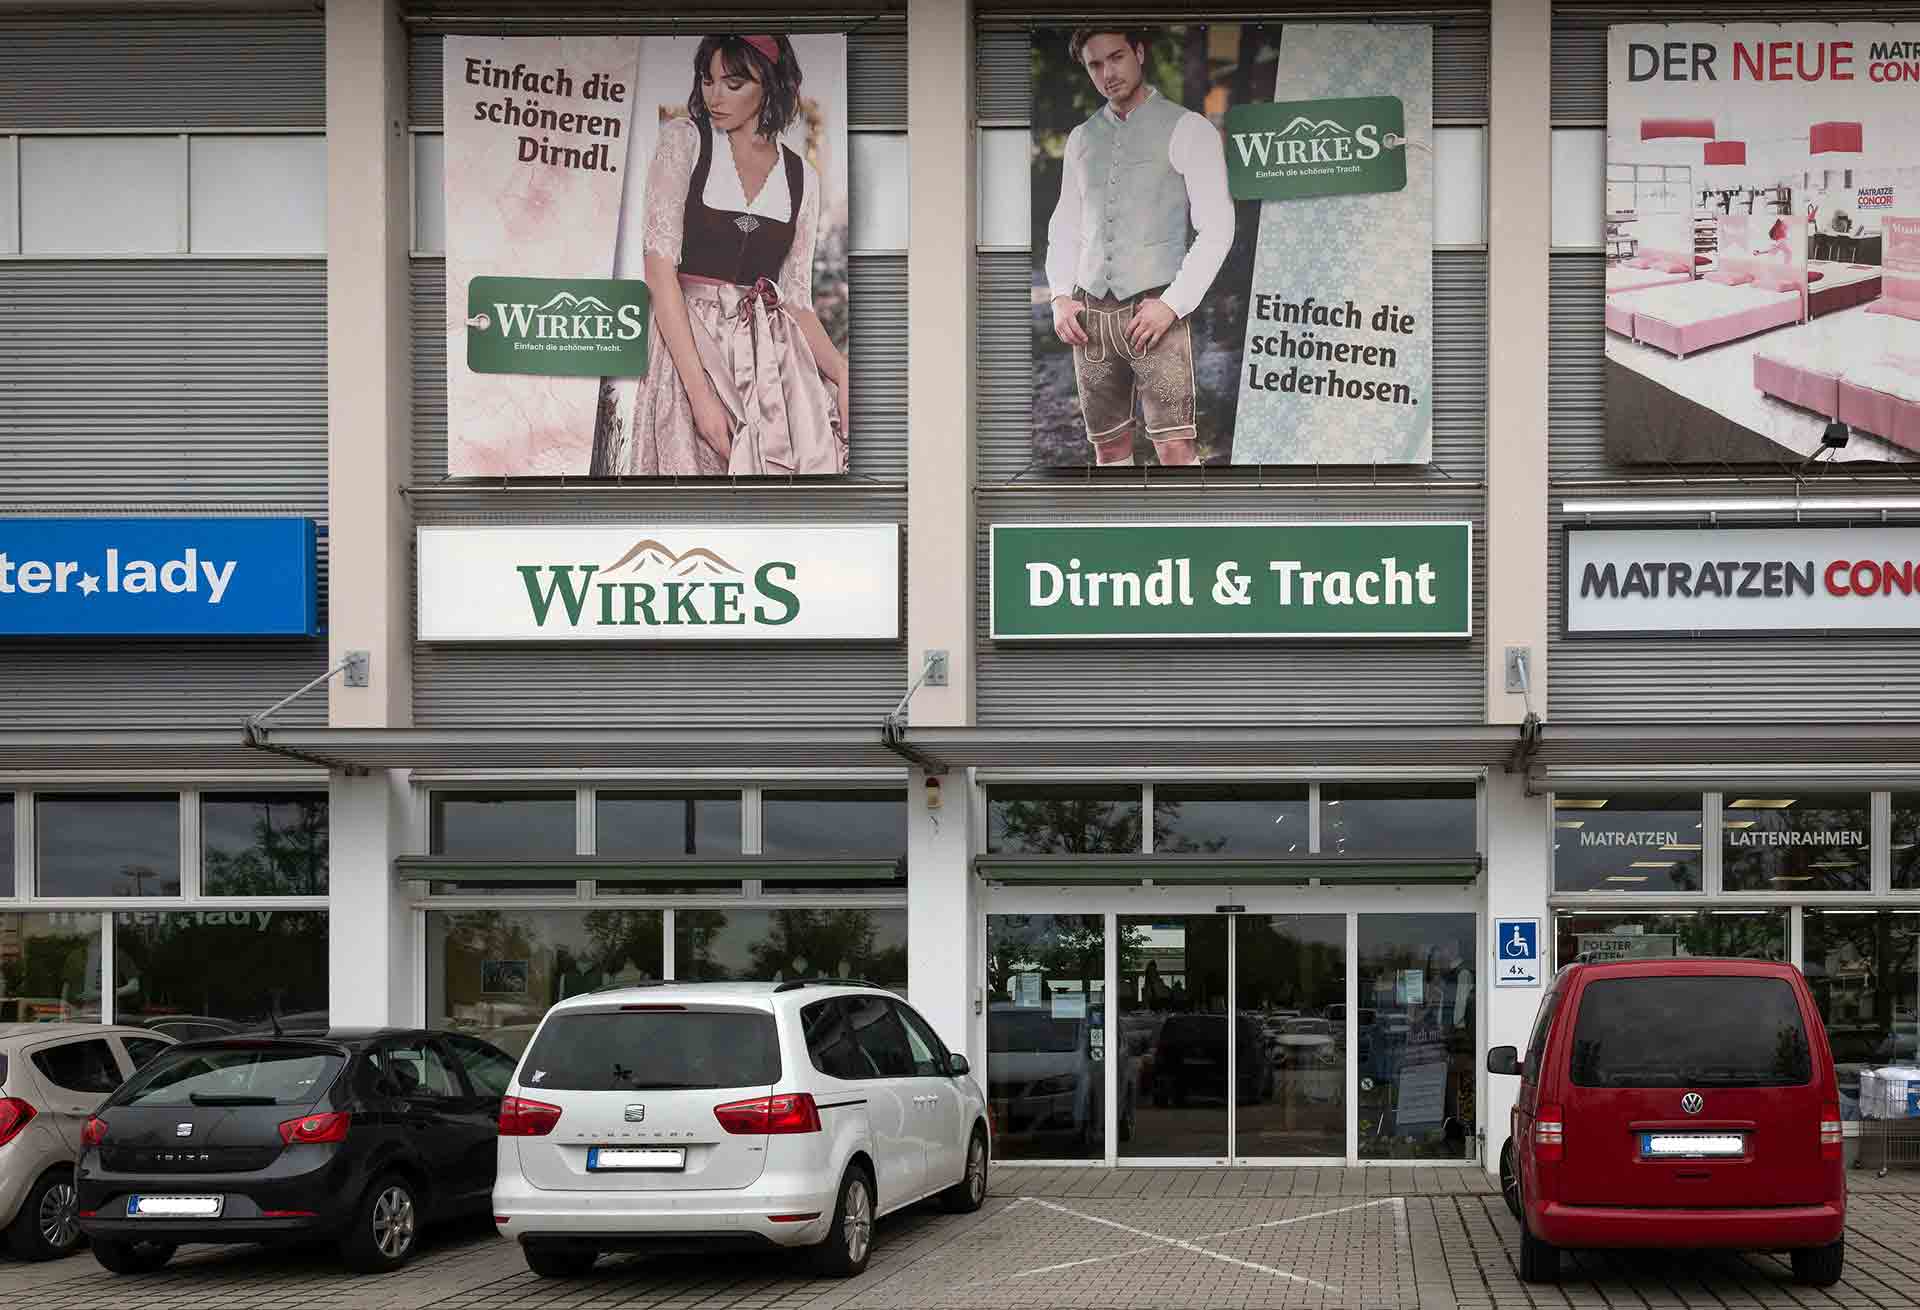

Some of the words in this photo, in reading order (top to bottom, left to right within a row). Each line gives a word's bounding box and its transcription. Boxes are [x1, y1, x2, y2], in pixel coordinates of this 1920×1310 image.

[465, 57, 572, 97] Einfach
[582, 73, 626, 103] die
[1628, 42, 1717, 81] DER
[1733, 41, 1854, 81] NEUE
[474, 97, 621, 138] schöneren
[518, 136, 617, 173] Dirndl.
[1232, 124, 1380, 167] WIRKES
[1255, 168, 1284, 178] Einfach
[1286, 167, 1298, 177] die
[493, 303, 642, 340] WIRKES
[1255, 294, 1362, 329] Einfach
[1371, 305, 1415, 334] die
[514, 343, 543, 351] Einfach
[546, 343, 557, 351] die
[559, 343, 593, 352] schönere
[1250, 330, 1397, 368] schöneren
[1249, 364, 1418, 405] Lederhosen.
[0, 552, 78, 594] ter
[107, 548, 237, 603] lady
[516, 561, 800, 626] WIRKES
[1025, 558, 1194, 607] Dirndl
[1211, 560, 1252, 606] &
[1270, 557, 1436, 606] Tracht
[1580, 560, 1814, 598] MATRATZEN
[1824, 559, 1920, 597] CON
[1580, 831, 1678, 847] MATRATZEN
[1730, 831, 1863, 847] LATTENRAHMEN
[1509, 965, 1524, 975] 4x
